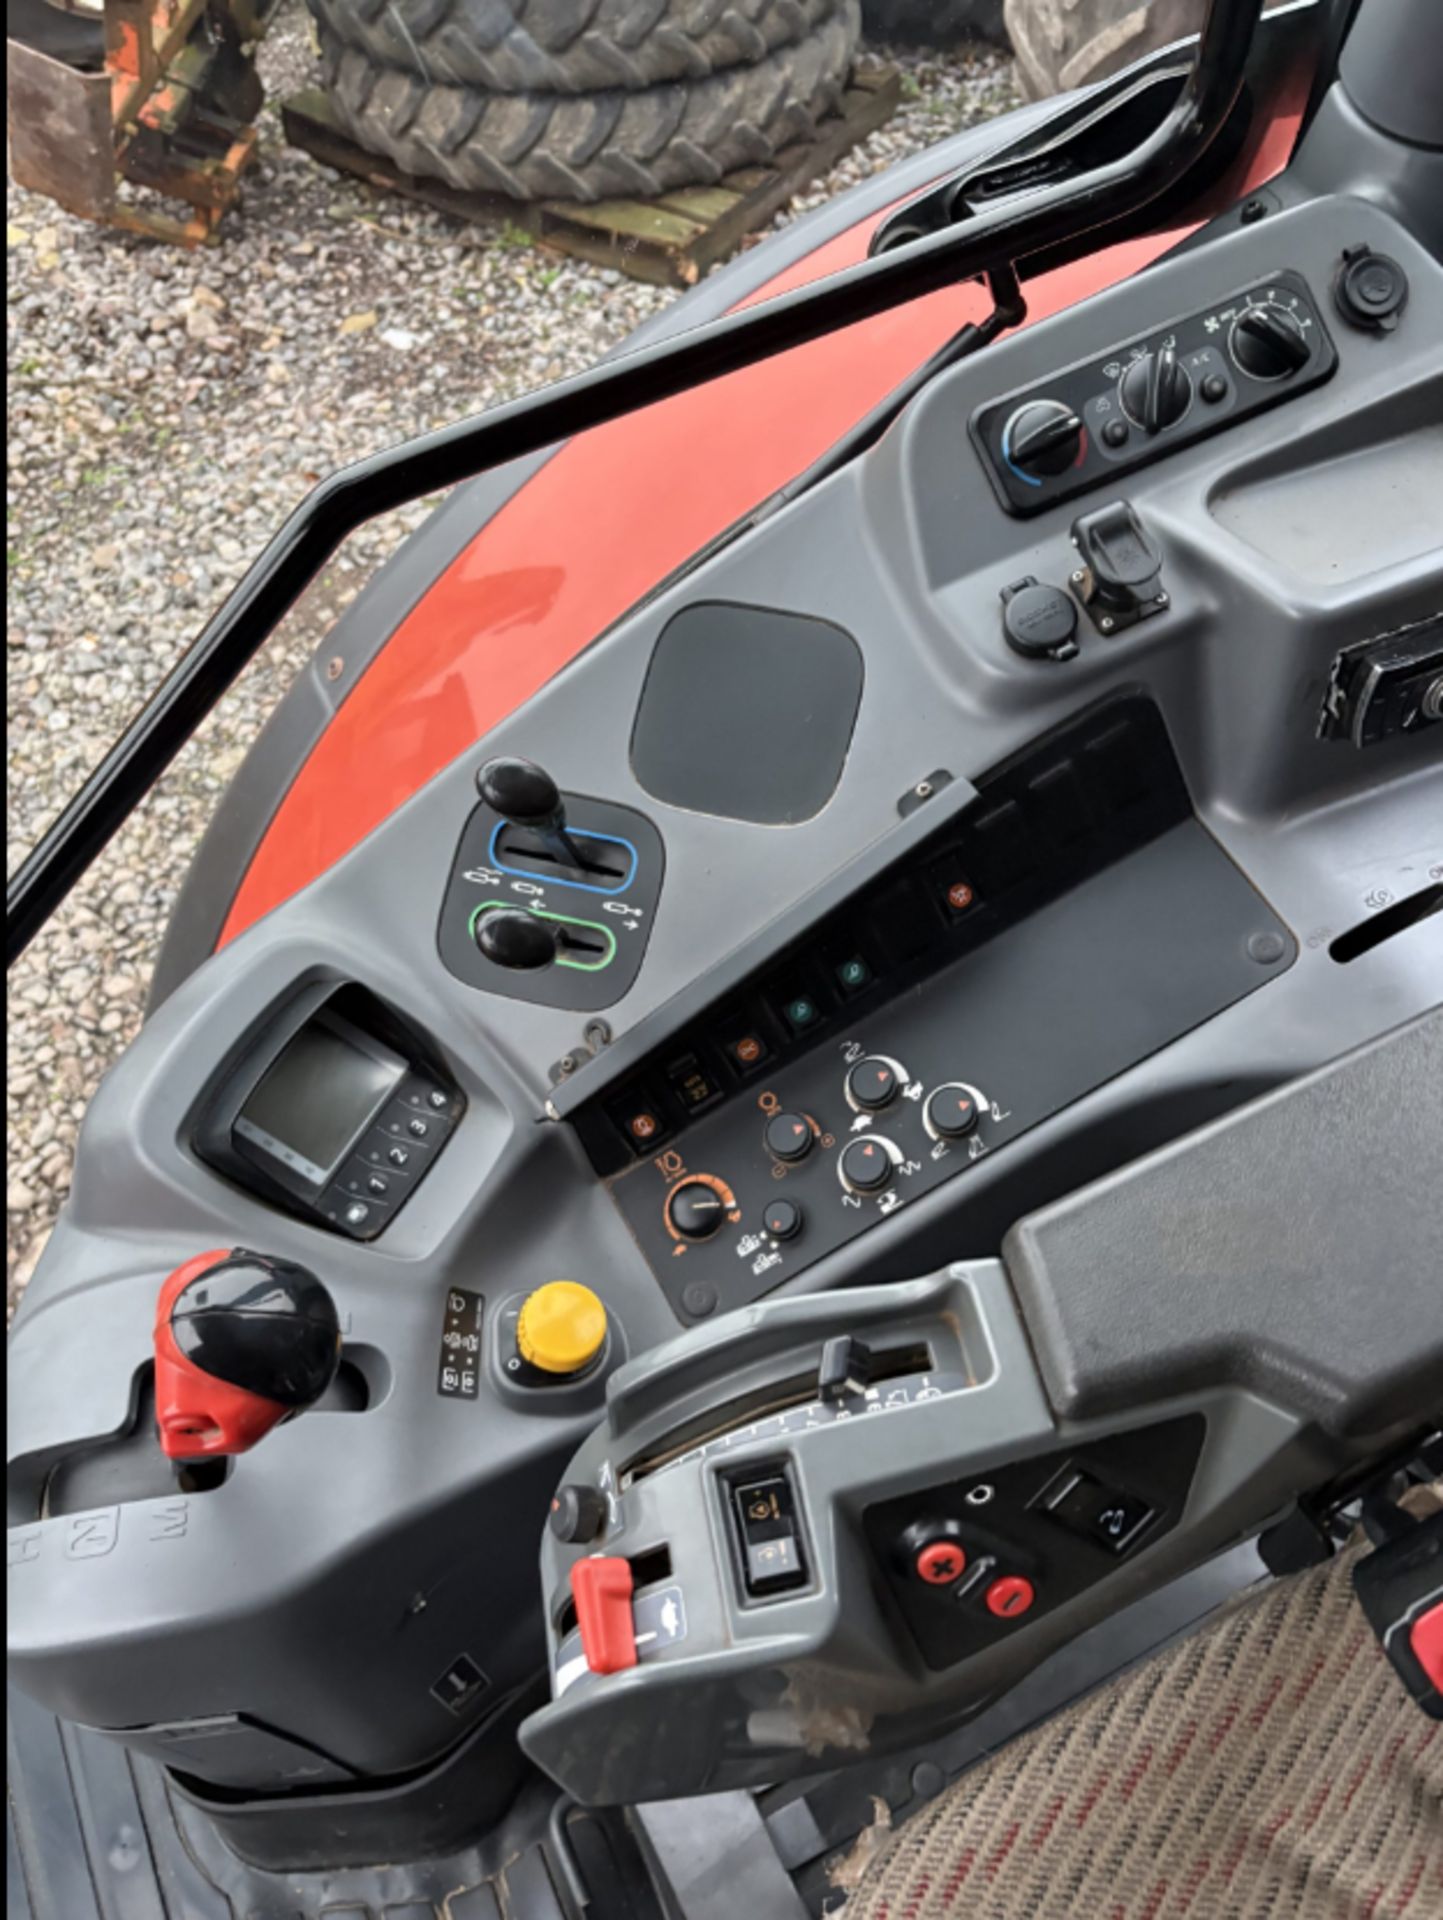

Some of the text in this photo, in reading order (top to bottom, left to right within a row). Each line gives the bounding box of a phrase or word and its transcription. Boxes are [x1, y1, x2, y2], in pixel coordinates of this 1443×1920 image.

[431, 1091, 447, 1107] 4
[410, 1119, 427, 1135] 3
[389, 1148, 408, 1164] 2
[370, 1178, 387, 1190] 1
